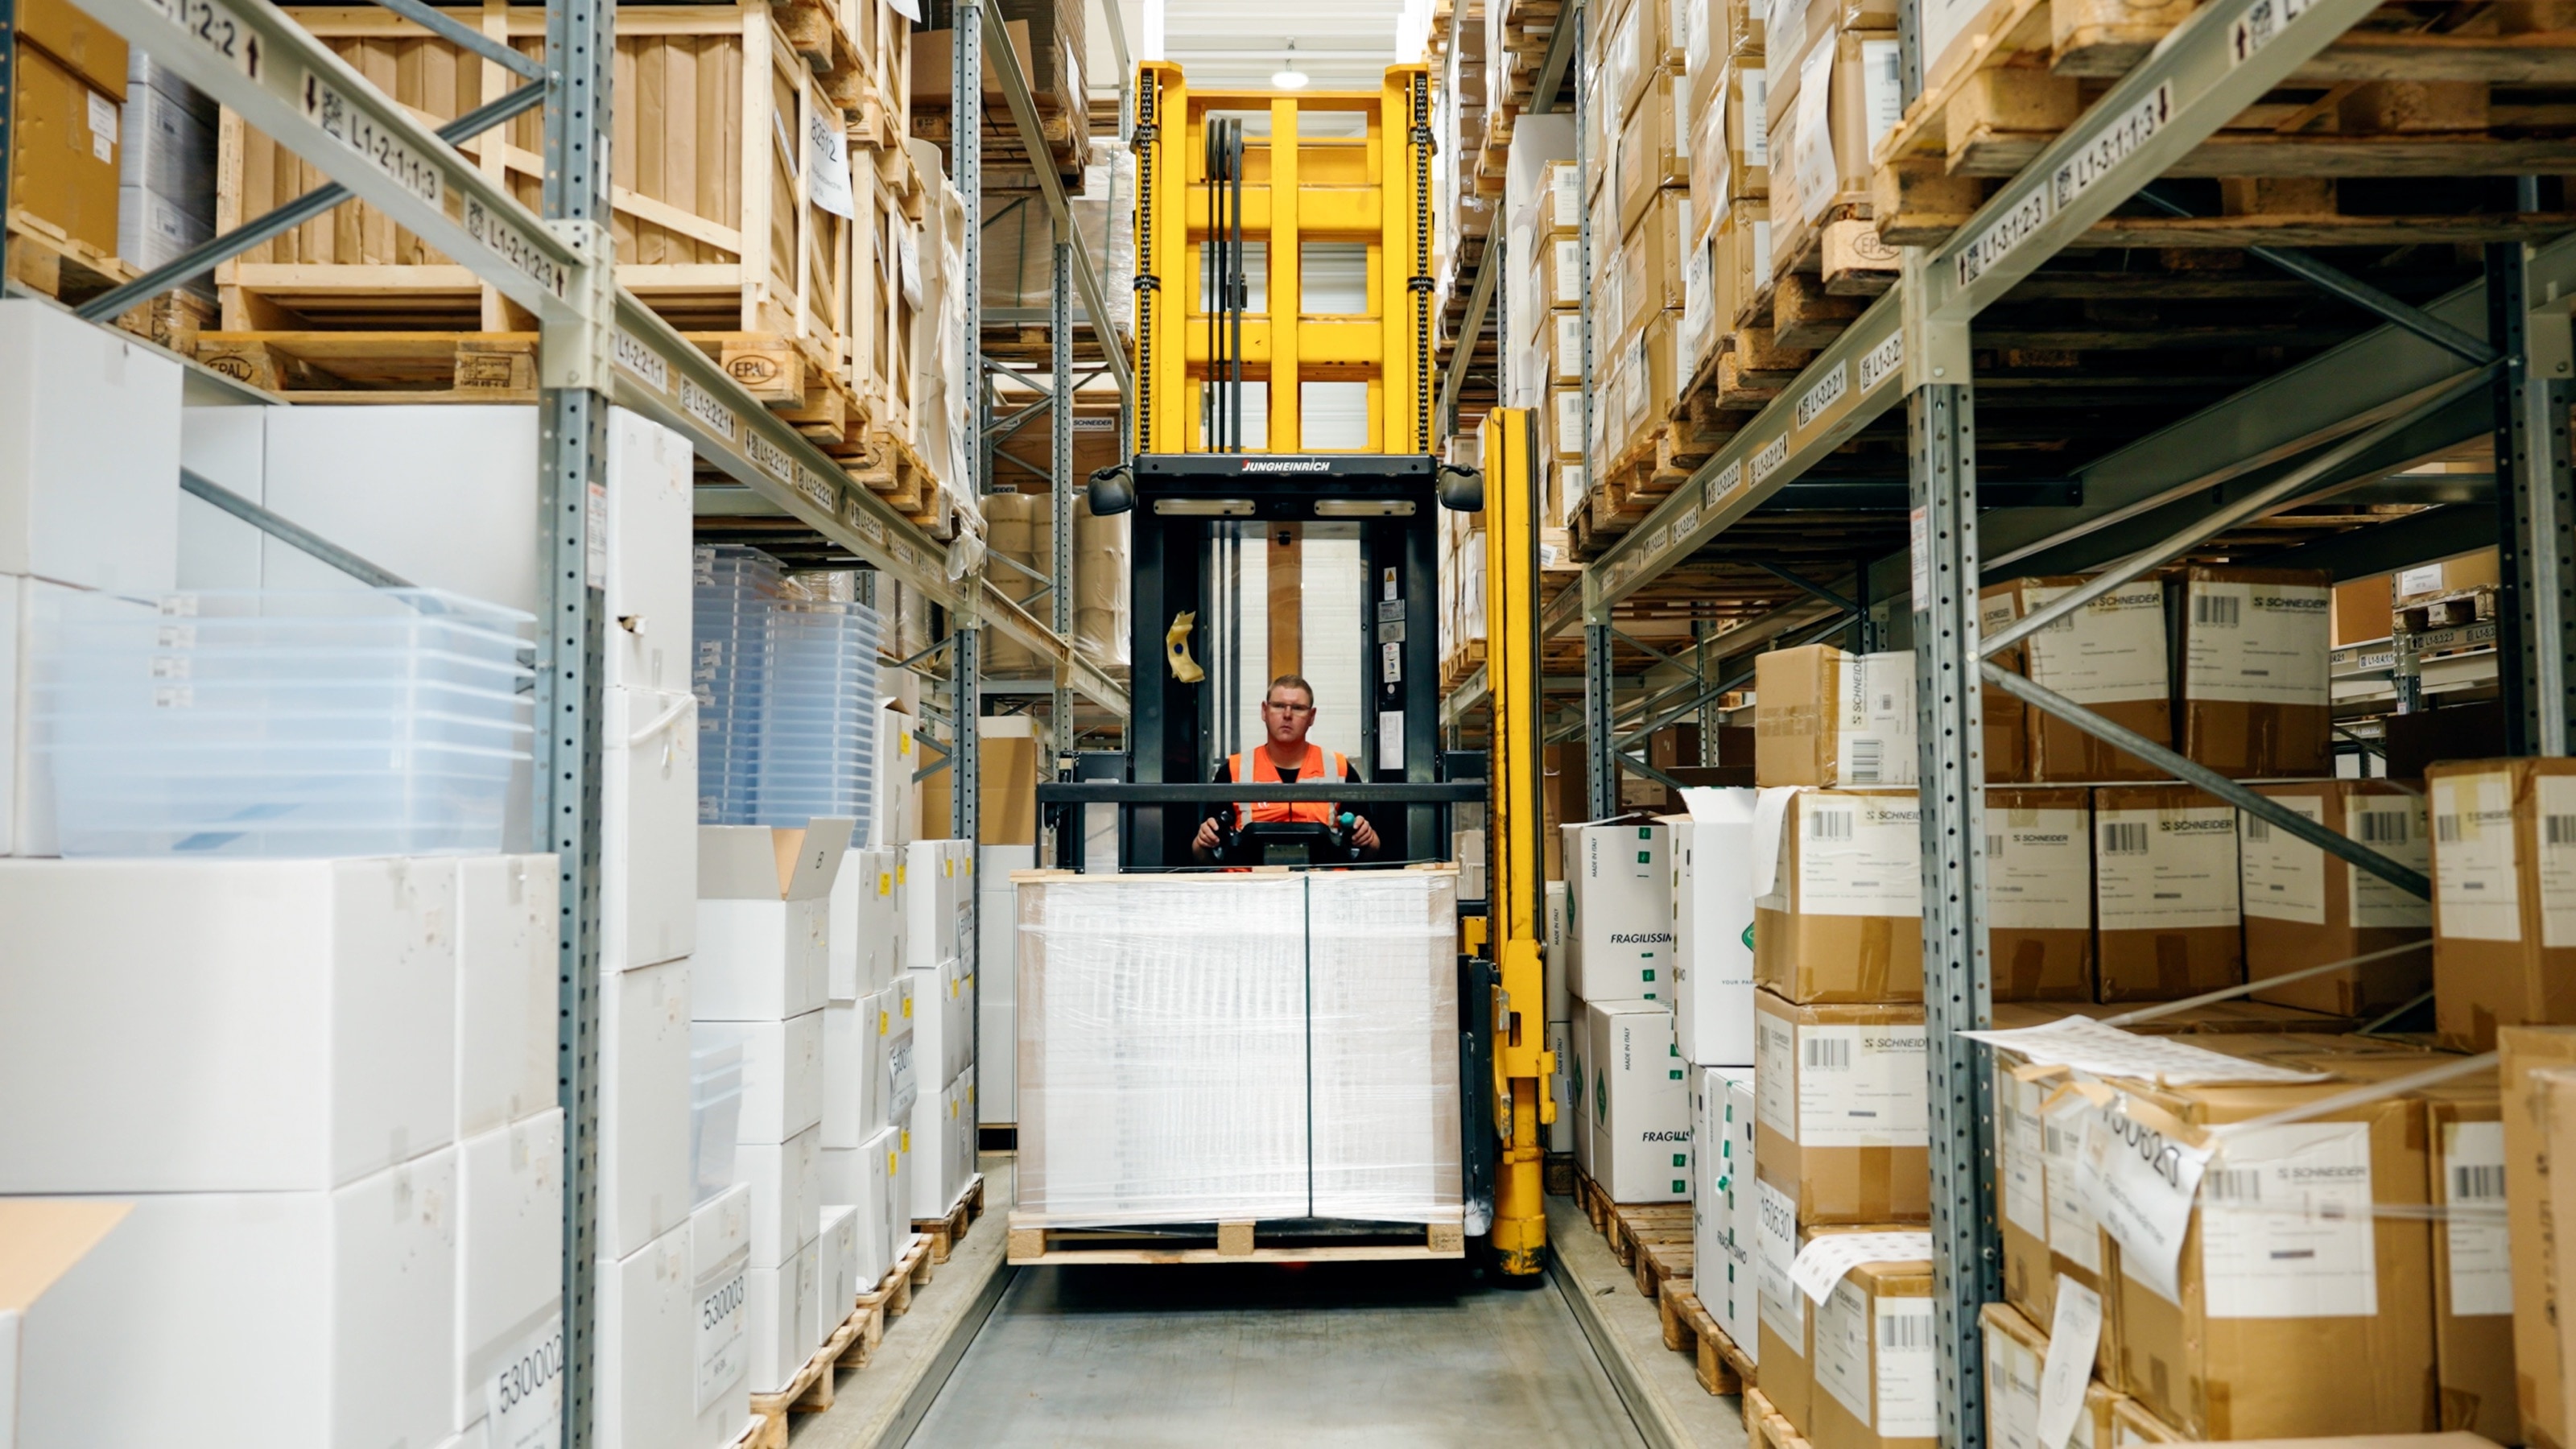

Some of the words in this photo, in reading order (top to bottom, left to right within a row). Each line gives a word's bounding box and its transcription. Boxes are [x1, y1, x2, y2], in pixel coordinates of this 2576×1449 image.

[1242, 459, 1330, 472] JUNGHEINRICH
[2099, 593, 2160, 606] SCHNEIDER
[2266, 597, 2327, 609] SCHNEIDER
[2174, 819, 2234, 831] SCHNEIDER
[2022, 834, 2068, 842] SCHNEIDER
[1592, 852, 1598, 861] IN
[1624, 1043, 1630, 1051] IN
[704, 1275, 744, 1331] 530003
[501, 1334, 564, 1414] 530002
